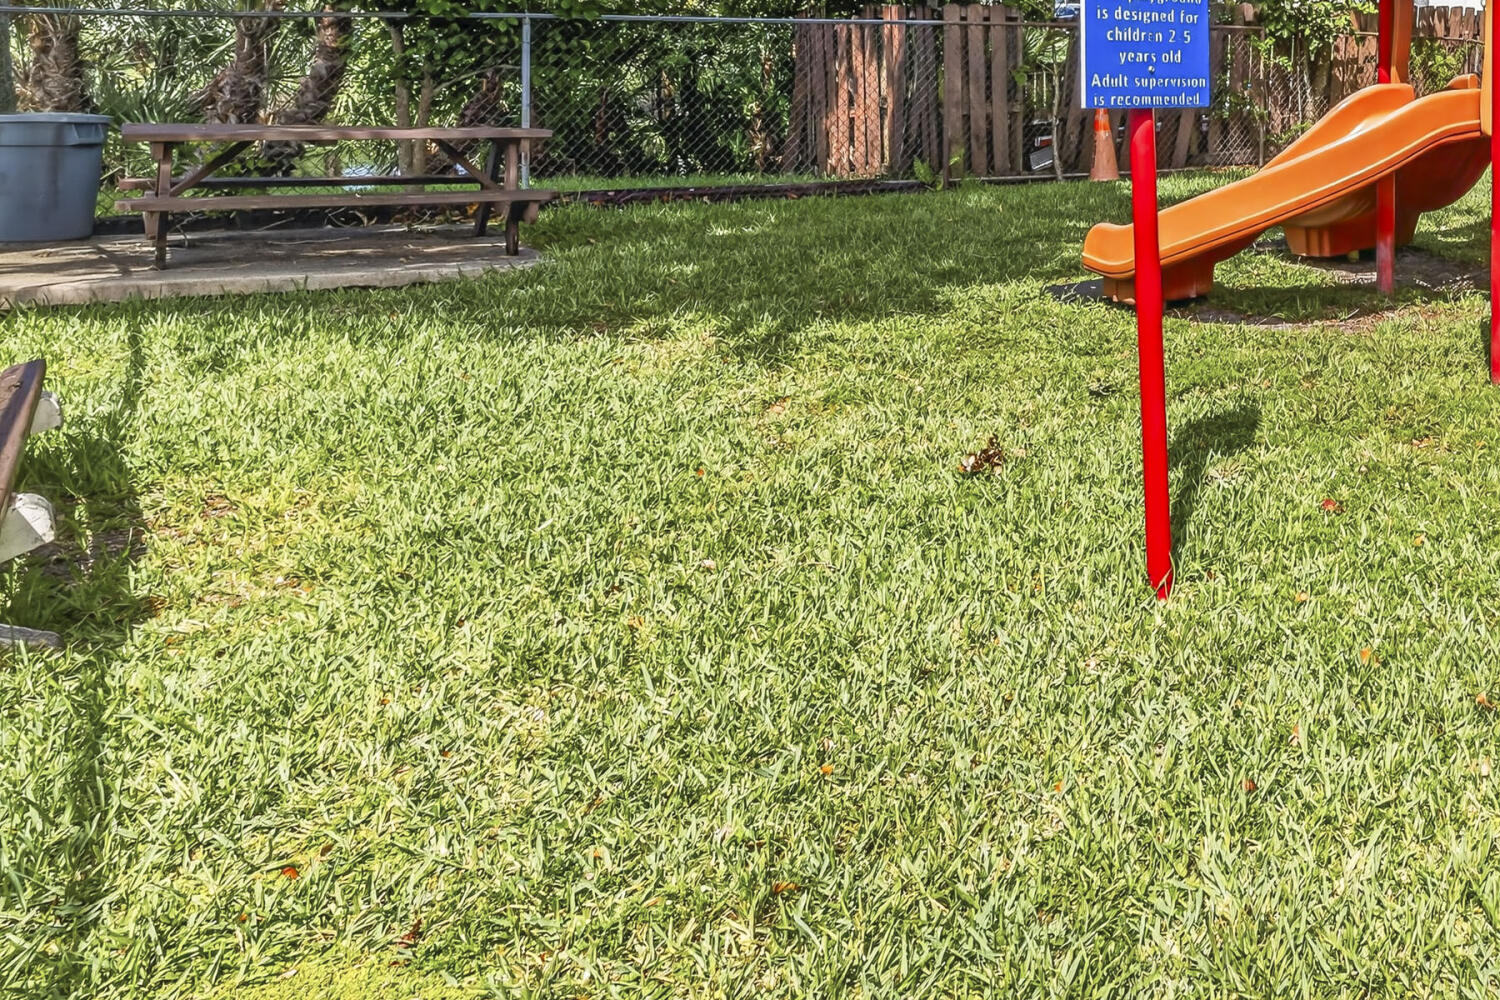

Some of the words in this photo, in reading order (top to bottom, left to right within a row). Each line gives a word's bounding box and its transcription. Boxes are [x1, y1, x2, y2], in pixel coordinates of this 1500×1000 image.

[1096, 5, 1108, 19] is
[1114, 6, 1174, 24] designed
[1180, 9, 1199, 24] for
[1106, 26, 1162, 42] children
[1119, 51, 1156, 64] years
[1162, 49, 1181, 63] old
[1091, 73, 1128, 88] Adult
[1135, 77, 1206, 90] supervision
[1094, 93, 1105, 106] is
[1110, 92, 1200, 105] recommended
